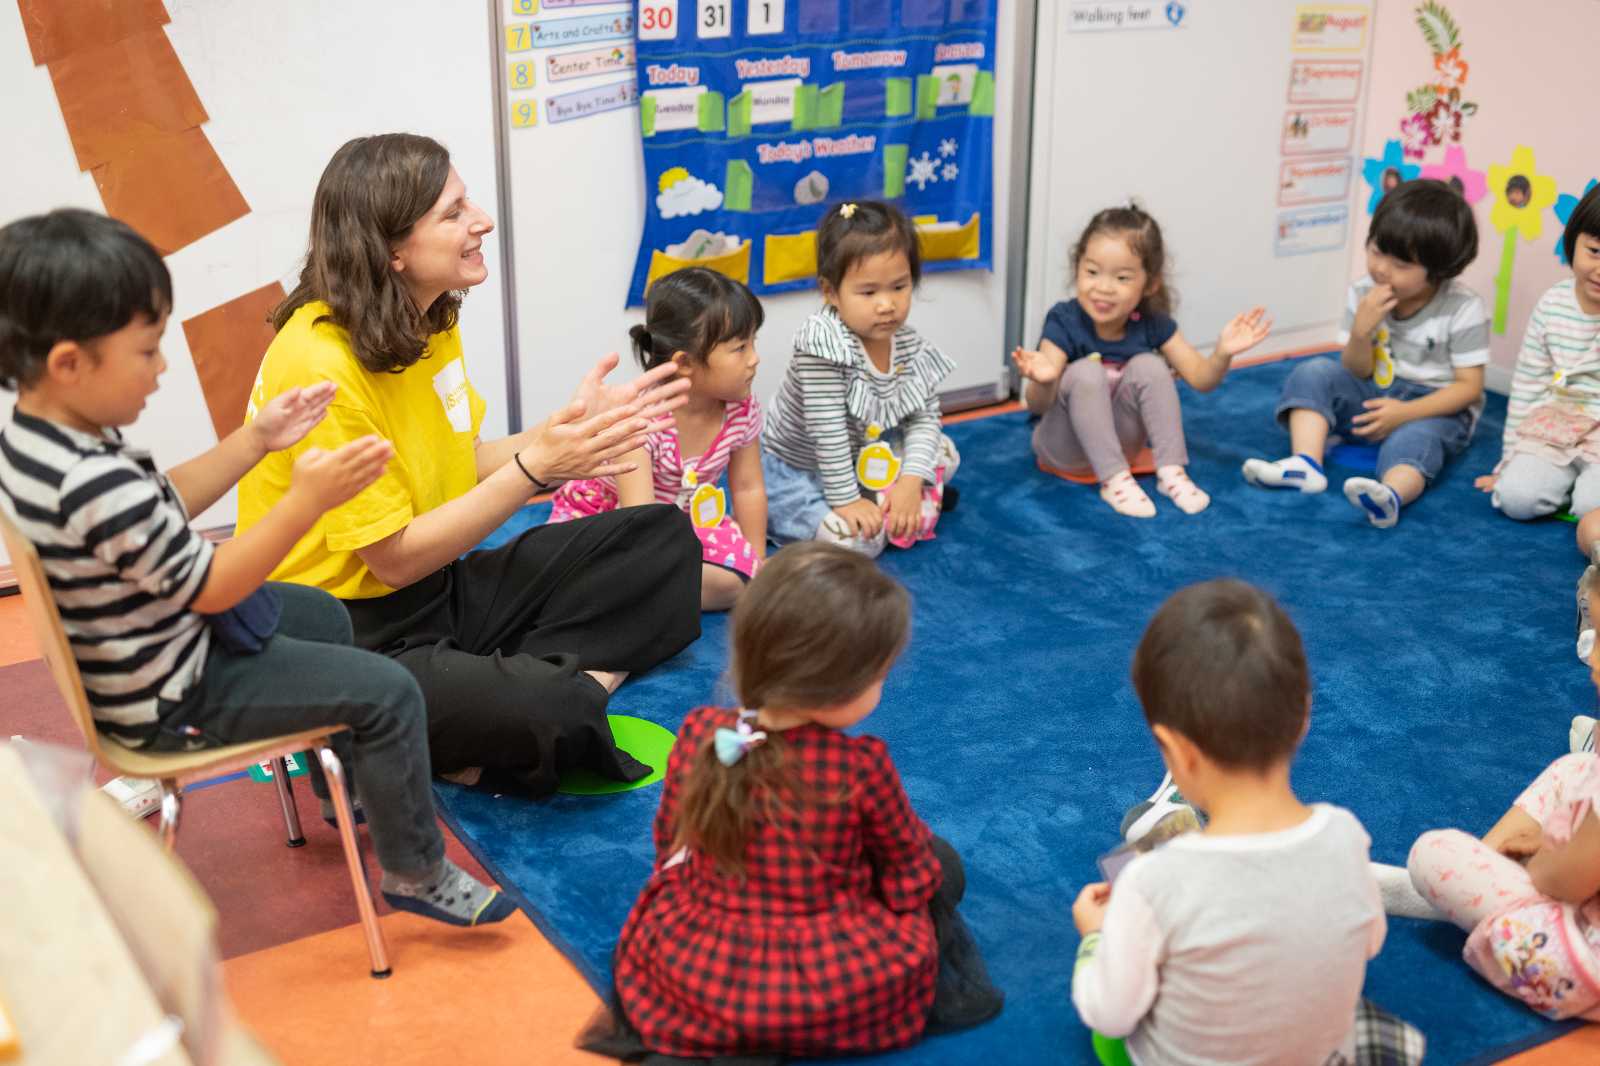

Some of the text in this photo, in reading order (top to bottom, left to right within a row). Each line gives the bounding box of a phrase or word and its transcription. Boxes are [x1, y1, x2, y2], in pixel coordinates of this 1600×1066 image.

[642, 7, 673, 30] 30
[704, 5, 725, 27] 31
[763, 3, 770, 24] 1
[512, 27, 525, 48] 7
[536, 30, 559, 41] Arts
[562, 28, 579, 38] and
[551, 61, 591, 76] Center
[735, 55, 810, 79] Yesterday
[832, 50, 907, 71] Tomorrow
[516, 63, 528, 84] 8
[646, 64, 699, 85] Today
[518, 103, 531, 124] 9
[758, 134, 876, 163] Today's Weather
